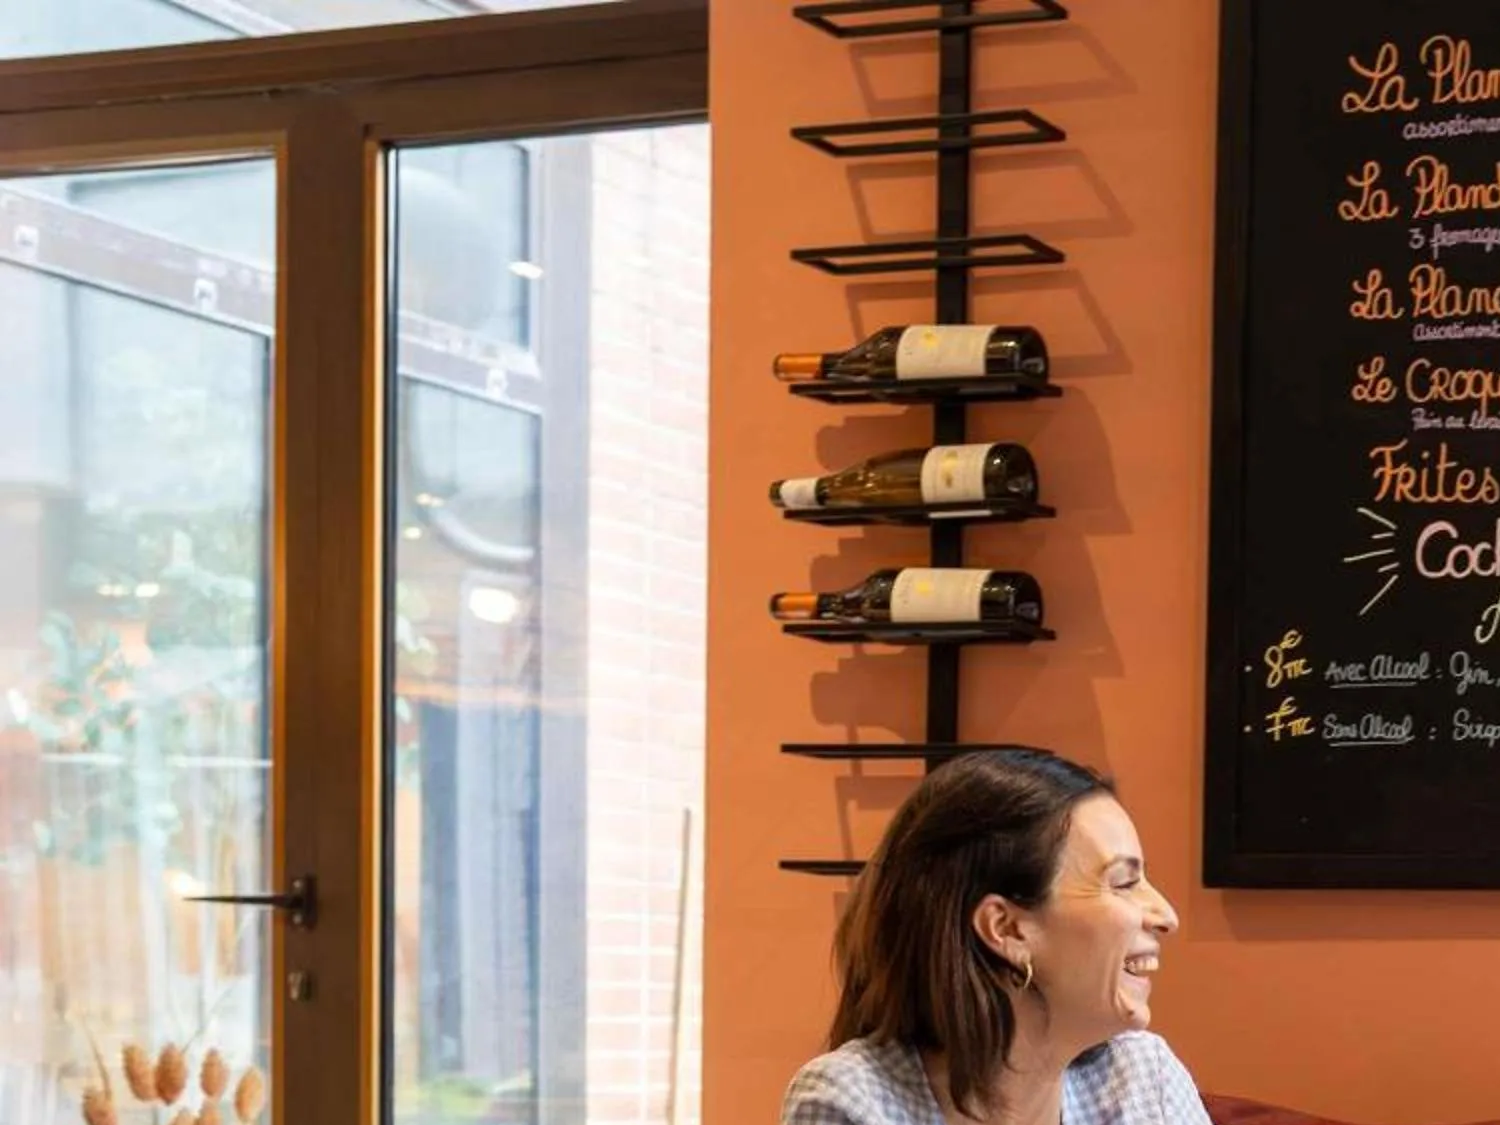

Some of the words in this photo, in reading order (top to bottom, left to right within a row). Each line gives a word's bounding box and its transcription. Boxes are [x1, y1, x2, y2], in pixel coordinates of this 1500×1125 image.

[1342, 43, 1420, 112] La
[1338, 160, 1398, 221] La
[1408, 227, 1425, 249] 3
[1350, 268, 1404, 320] La
[1351, 356, 1398, 401] Le
[1369, 439, 1500, 503] Frites
